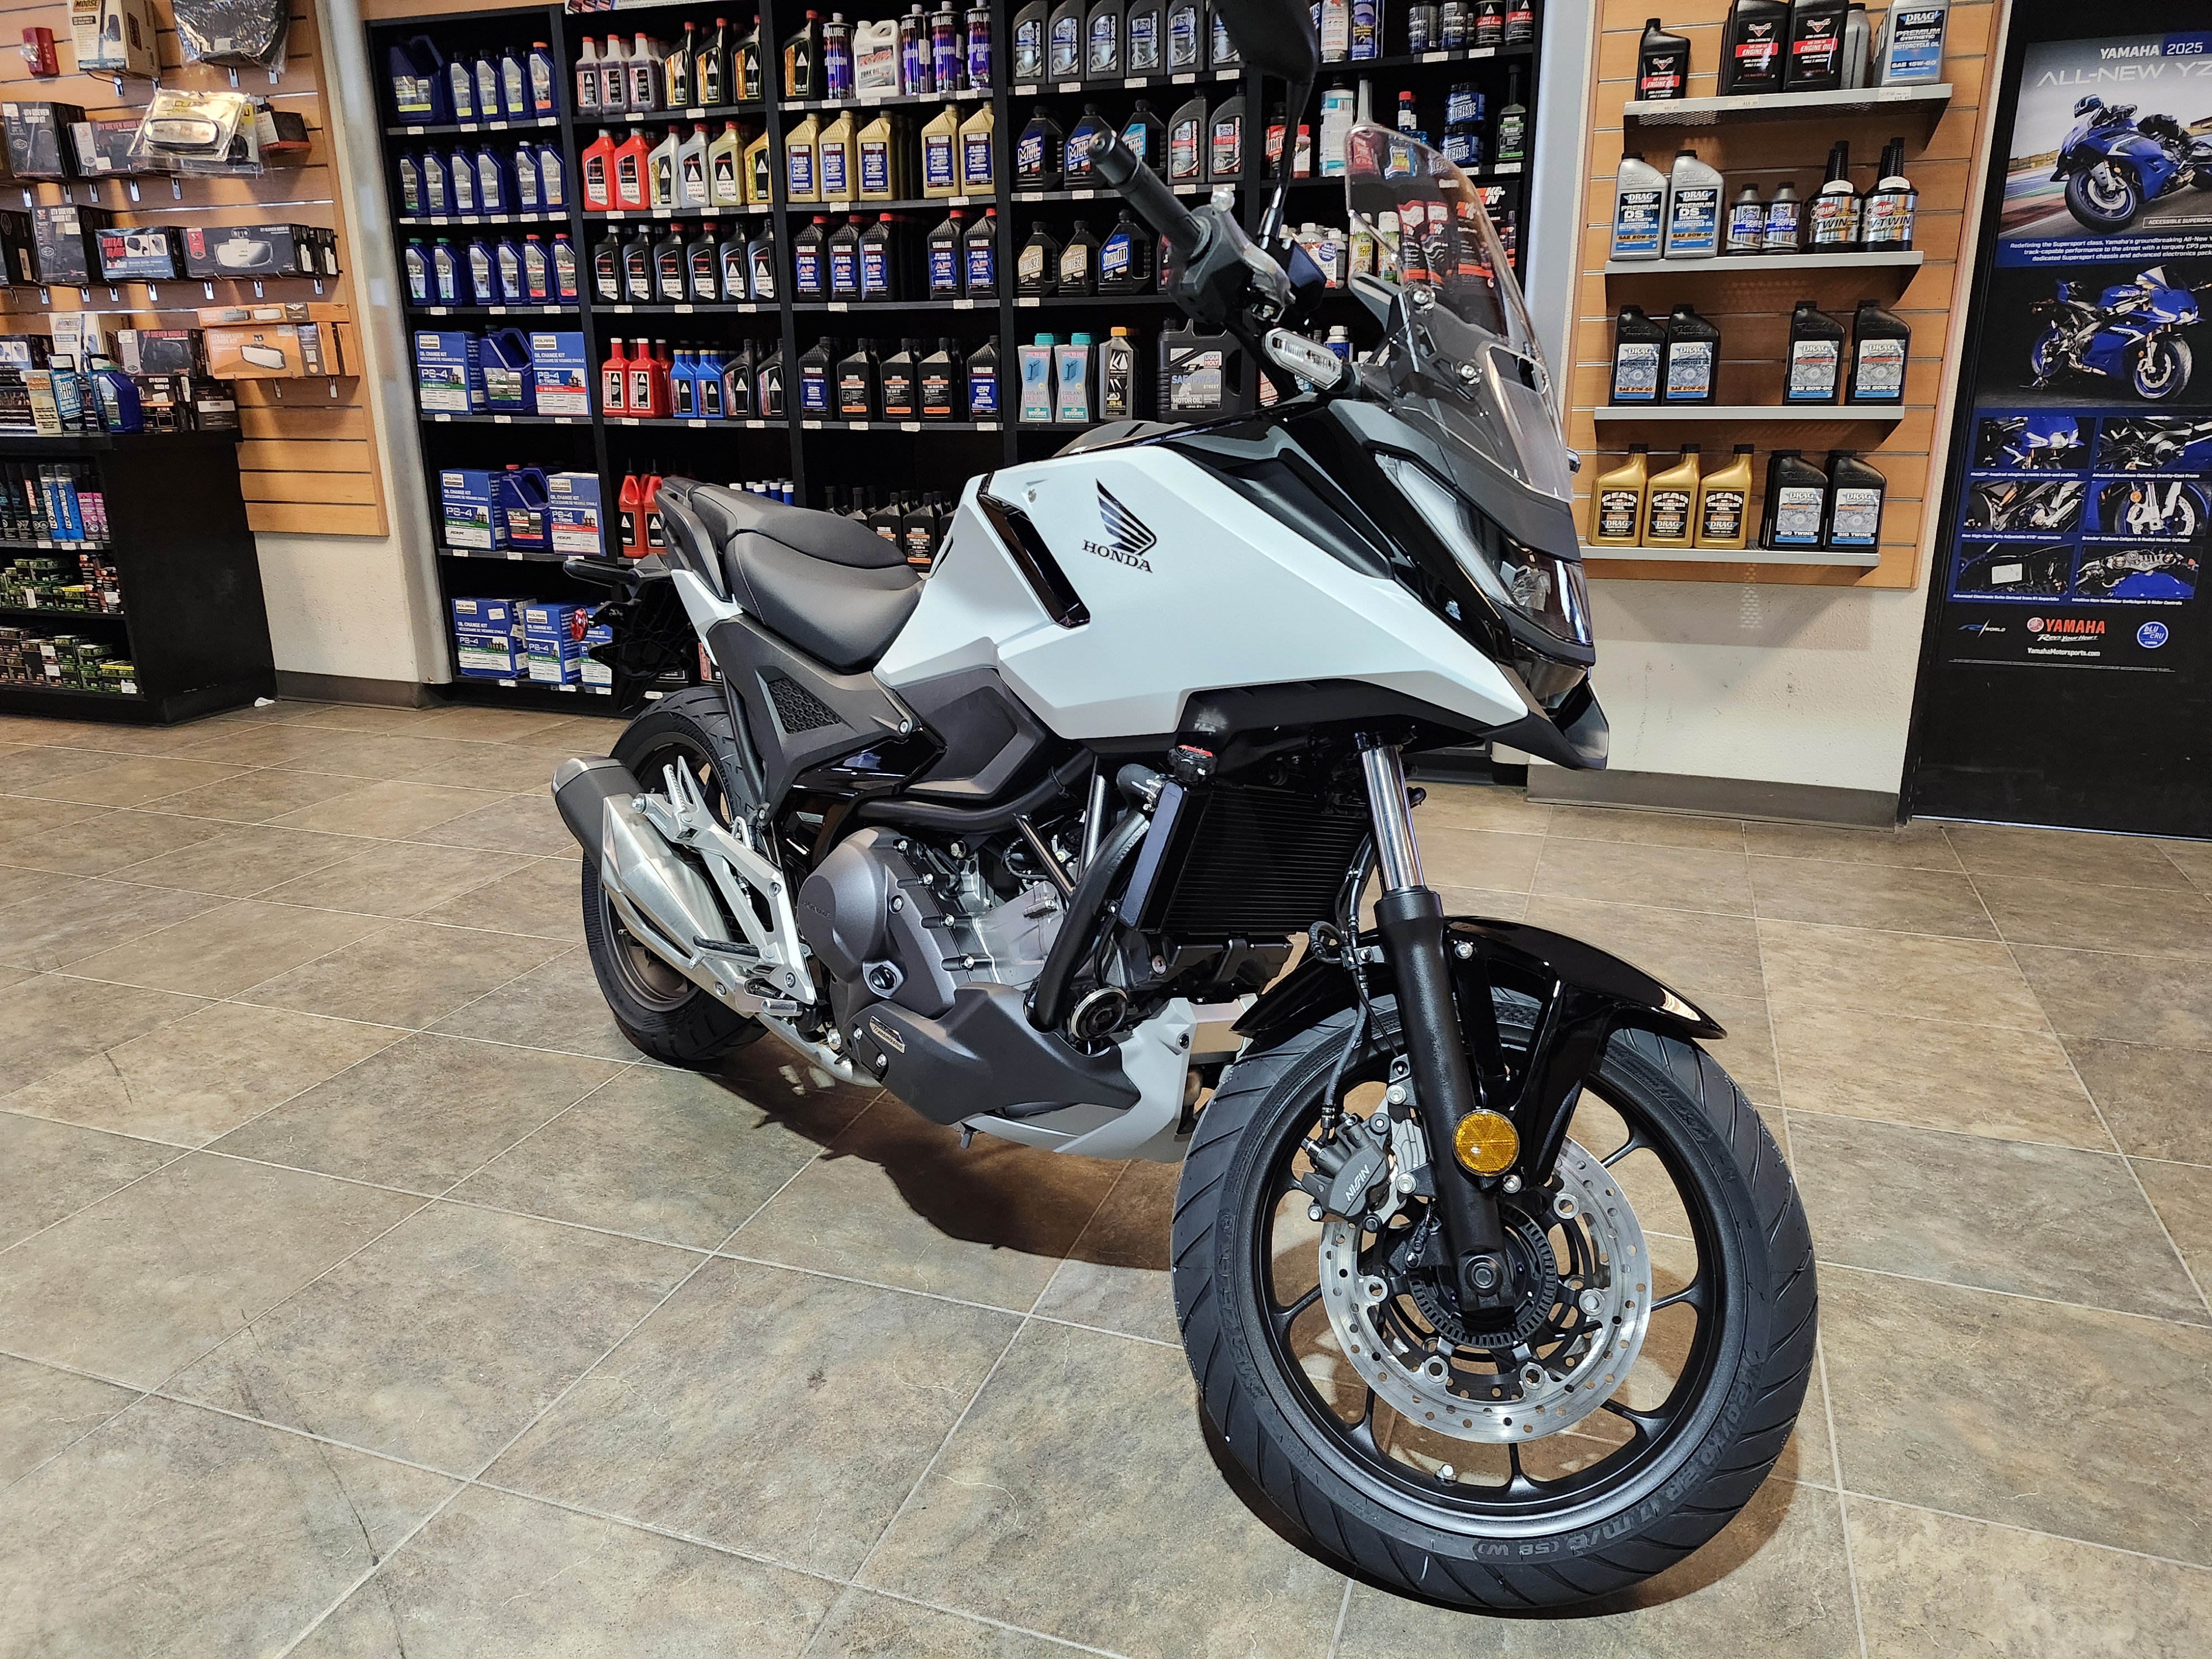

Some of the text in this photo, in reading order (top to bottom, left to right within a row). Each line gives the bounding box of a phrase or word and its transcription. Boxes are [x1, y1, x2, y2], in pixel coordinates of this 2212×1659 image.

[1907, 12, 1935, 23] DRAG
[1896, 28, 1940, 38] PREMIUM
[1893, 42, 1930, 50] MOTORCYCLE
[2100, 42, 2203, 59] YAMAHA 2025
[859, 49, 892, 67] KYB
[976, 53, 985, 62] OIL
[861, 69, 872, 79] FORK
[2036, 63, 2166, 87] ALL-NEW
[1447, 102, 1477, 121] GREASE
[1484, 186, 1505, 205] K&N
[1683, 191, 1709, 199] DRAG
[1825, 205, 1838, 213] LINE
[1883, 204, 1895, 212] LINE
[1871, 216, 1911, 227] V-TWIN
[421, 369, 448, 378] PS-4
[1172, 375, 1188, 384] SAE
[56, 378, 80, 402] FAB1
[25, 480, 36, 508] MOTUL
[1601, 492, 1637, 503] GEAR
[1652, 492, 1688, 504] GEAR
[1705, 493, 1743, 504] GEAR
[43, 489, 58, 529] SILICON
[446, 507, 472, 517] PS-4
[1082, 539, 1154, 573] HONDA
[2046, 619, 2105, 634] YAMAHA
[2027, 647, 2100, 656] YamahaMotorsports.com
[803, 899, 831, 916] HONDA
[873, 1026, 903, 1050] Transmission
[1345, 1164, 1371, 1202] NISSIN
[1218, 1241, 1260, 1394] METZELER
[1478, 1543, 1510, 1556] W)
